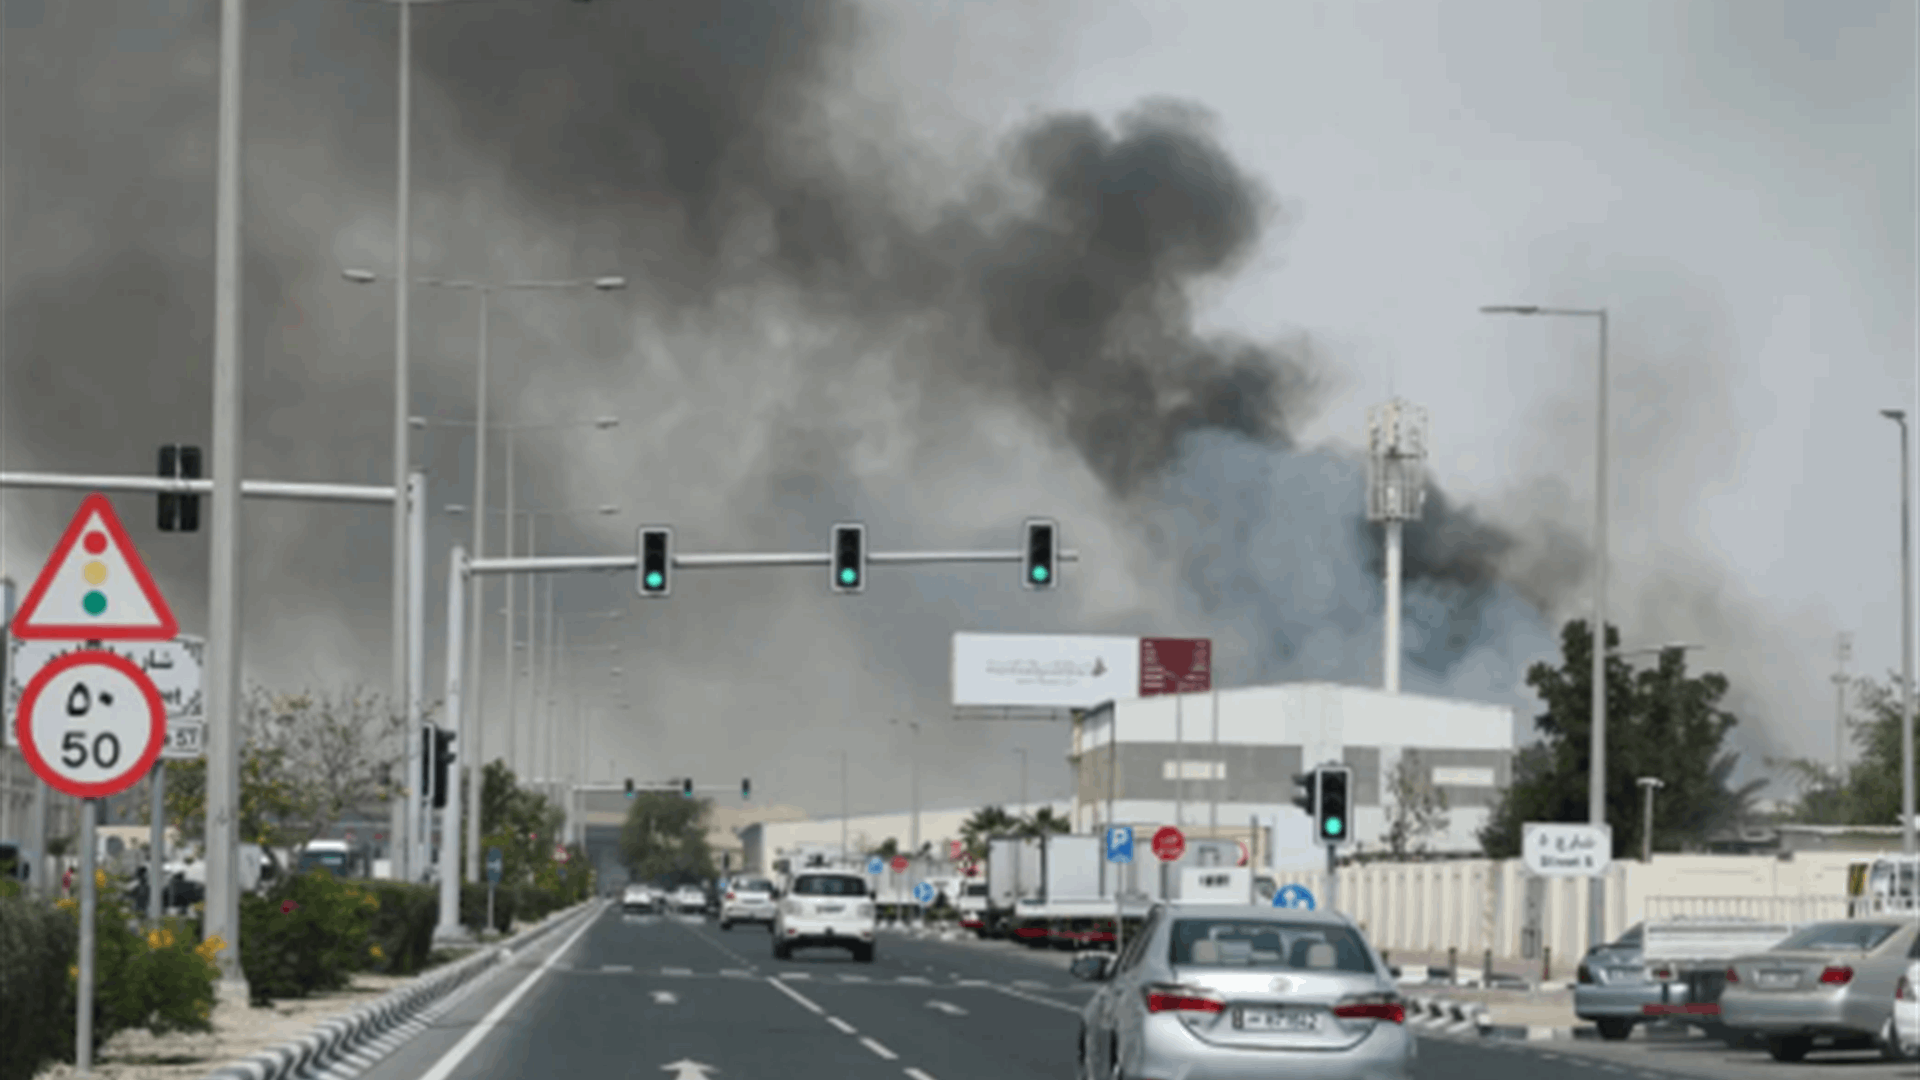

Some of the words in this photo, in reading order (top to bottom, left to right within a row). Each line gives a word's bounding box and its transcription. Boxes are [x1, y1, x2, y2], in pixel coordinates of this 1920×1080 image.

[66, 682, 114, 717] ٥٠
[61, 731, 120, 768] 50
[1540, 855, 1580, 868] Street
